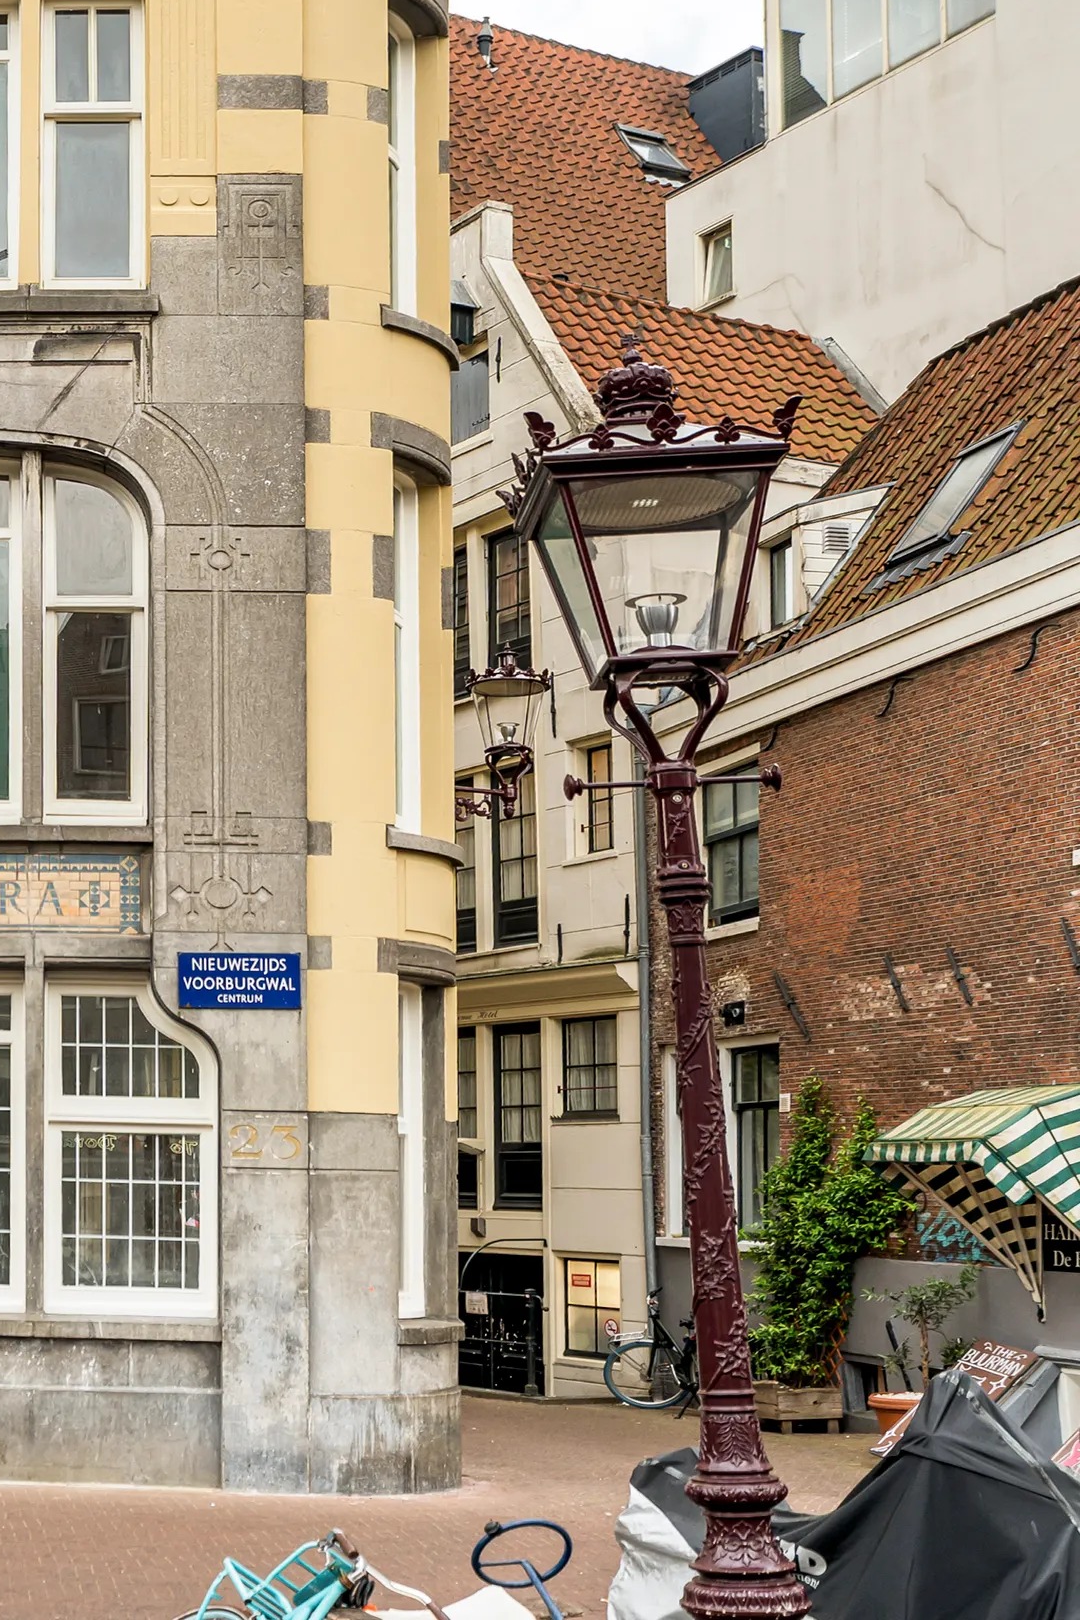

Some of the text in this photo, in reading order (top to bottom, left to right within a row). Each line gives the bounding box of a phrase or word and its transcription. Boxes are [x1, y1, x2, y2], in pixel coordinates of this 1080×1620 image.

[191, 958, 287, 975] NIEUWEZIJDS
[182, 976, 296, 991] VOORBURGWAL
[217, 994, 263, 1003] CENTRUM
[229, 1124, 302, 1160] 23
[1053, 1250, 1072, 1267] De
[991, 1345, 1017, 1360] THE
[962, 1348, 1025, 1376] BUURMAN
